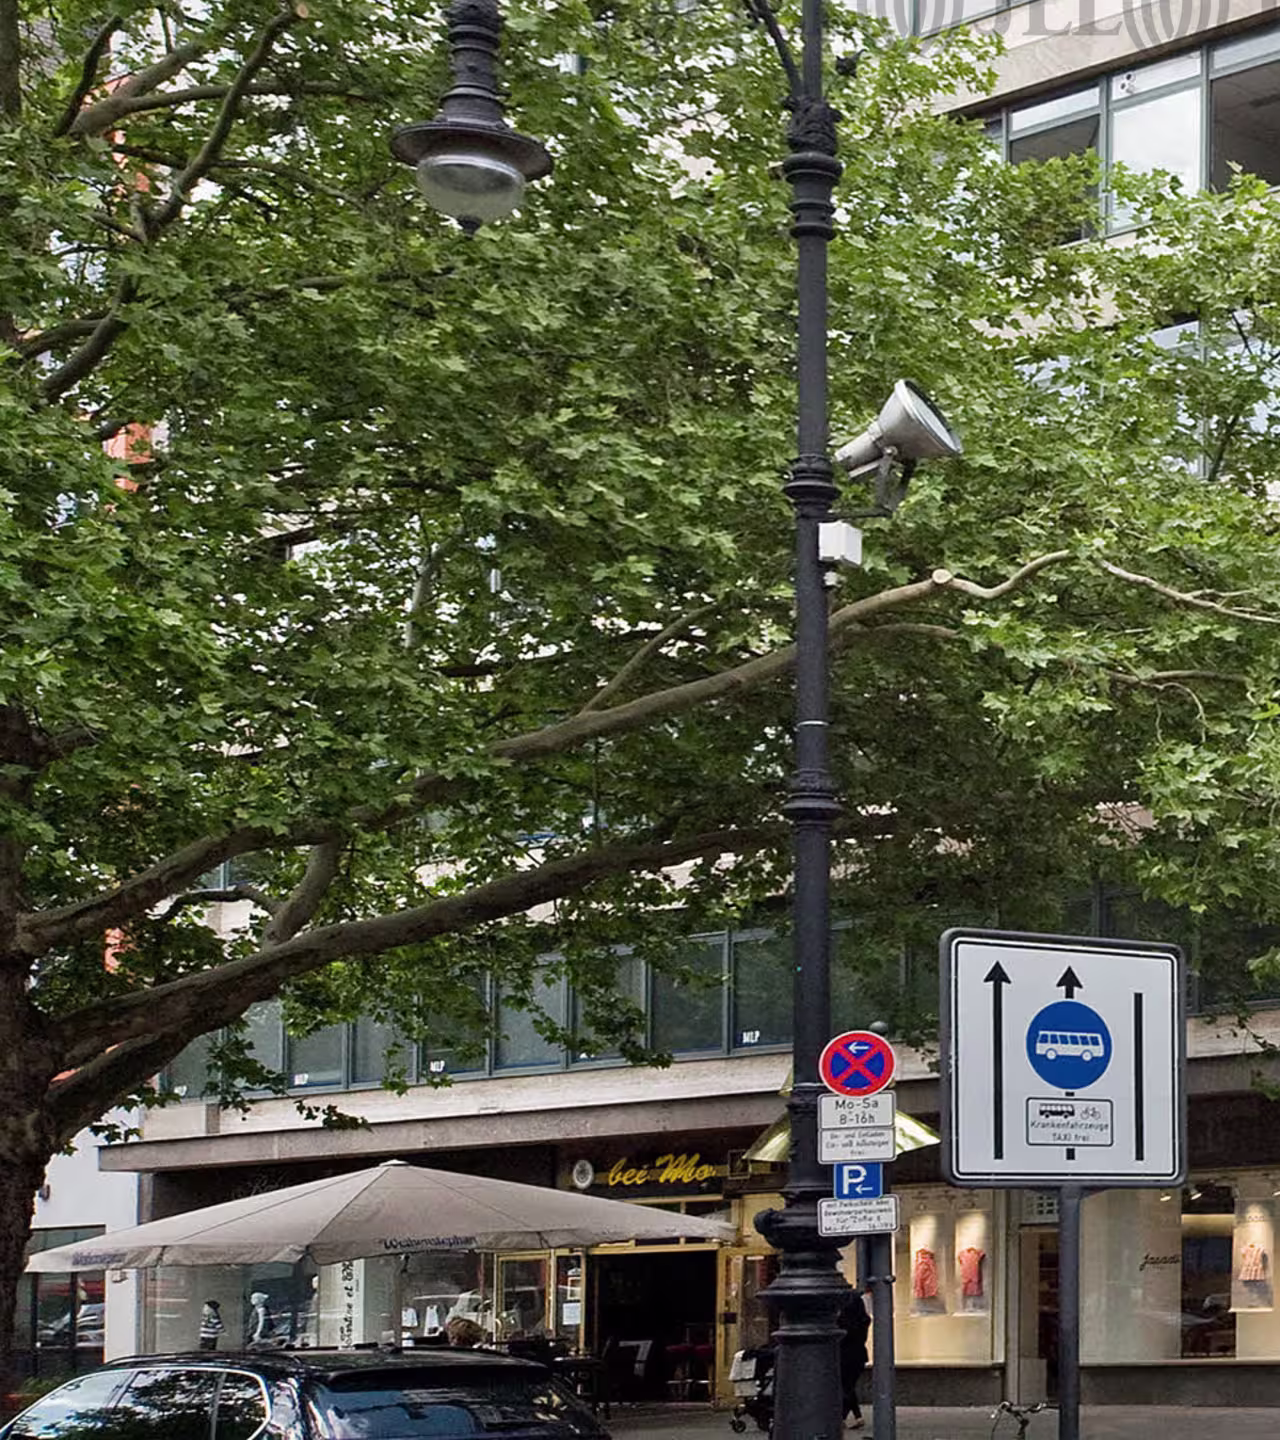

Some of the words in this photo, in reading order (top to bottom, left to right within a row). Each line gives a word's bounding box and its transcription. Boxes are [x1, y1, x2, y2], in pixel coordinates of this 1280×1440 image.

[742, 1030, 760, 1044] MLP
[835, 1097, 879, 1110] Mo-Sa
[839, 1113, 875, 1125] 8-16h
[1030, 1120, 1110, 1133] Krankenfahrzeuge
[608, 1157, 649, 1186] bei
[842, 1165, 867, 1194] P
